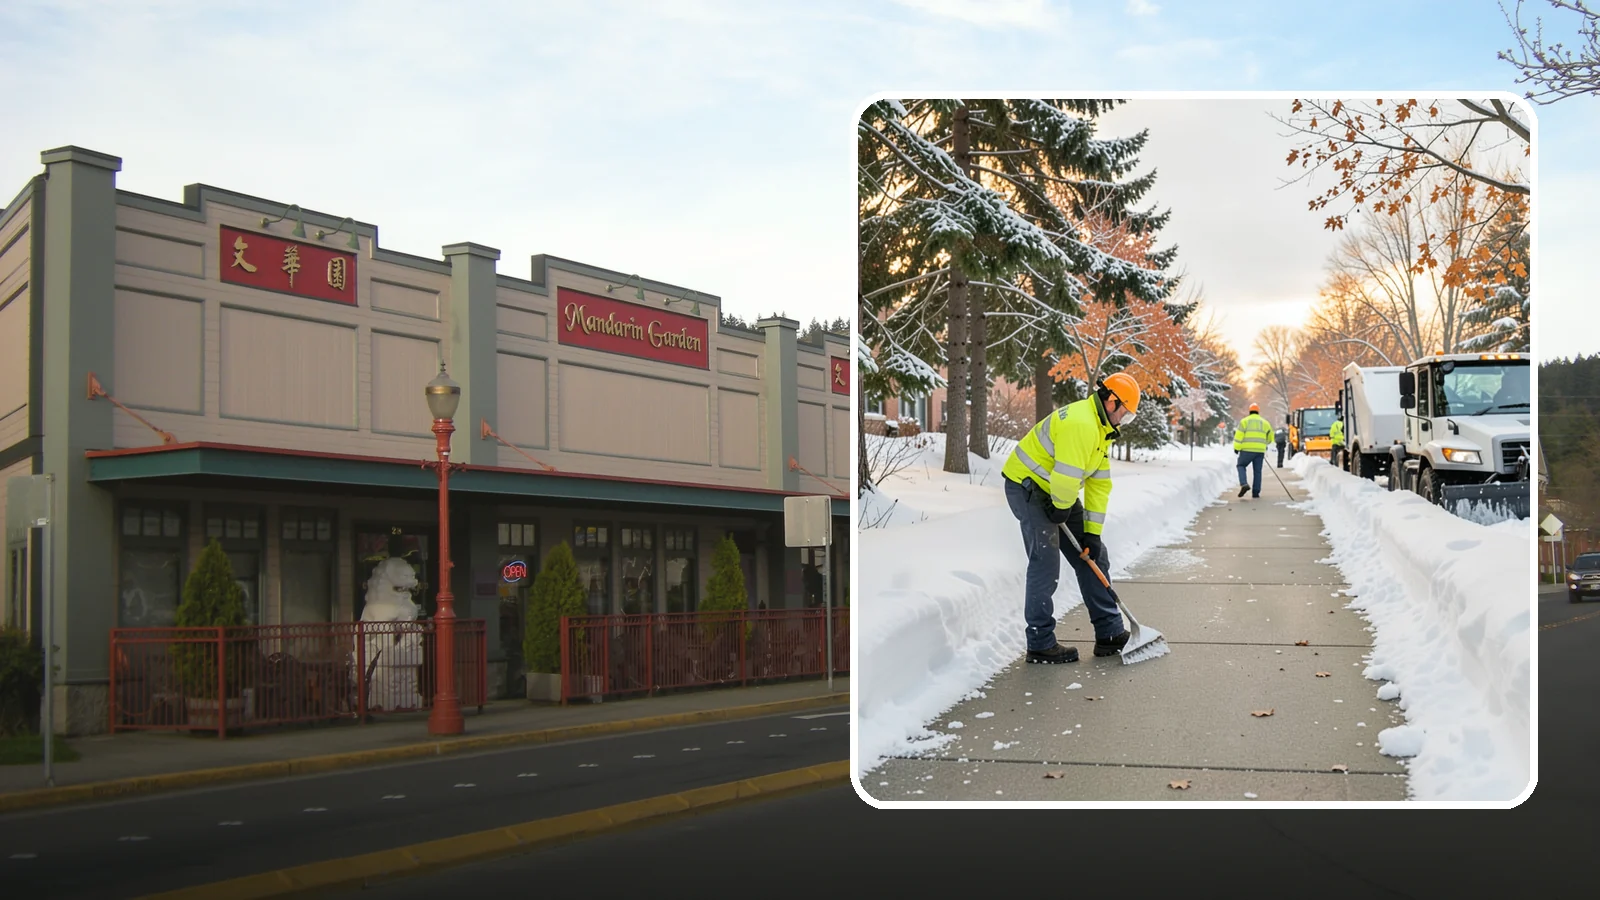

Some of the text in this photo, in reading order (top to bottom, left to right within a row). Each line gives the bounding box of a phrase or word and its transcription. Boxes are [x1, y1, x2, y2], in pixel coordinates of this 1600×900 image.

[231, 235, 346, 290] 文華園
[564, 302, 701, 352] Mandarin Garden
[503, 565, 527, 578] OPEN
